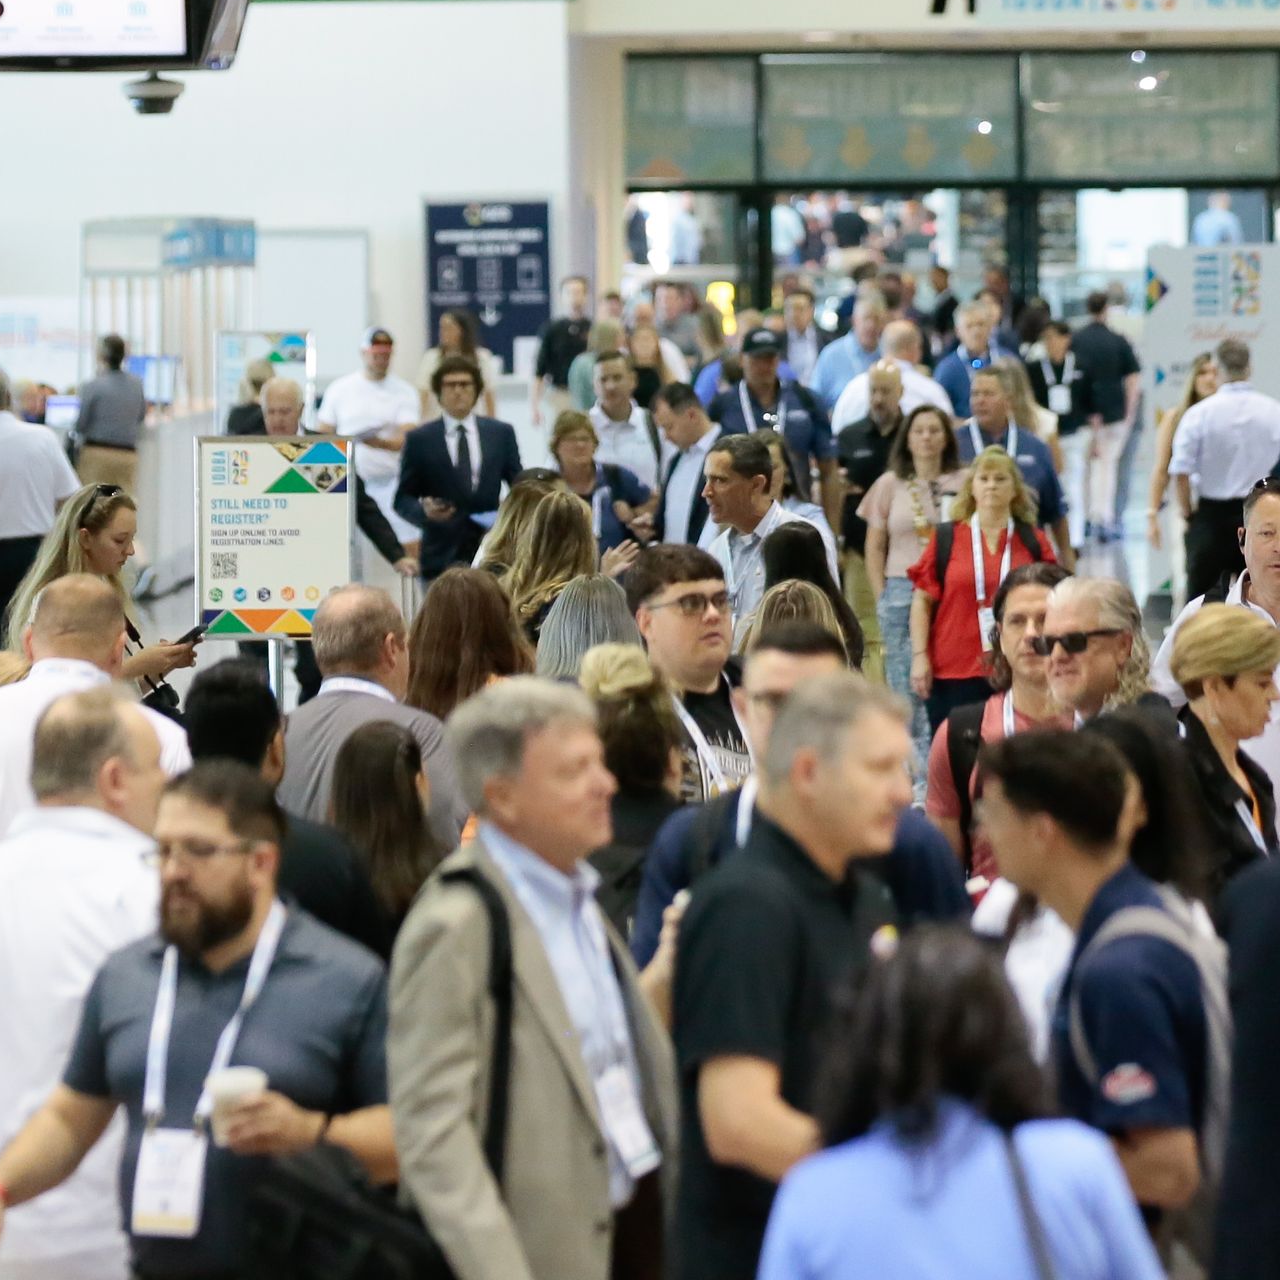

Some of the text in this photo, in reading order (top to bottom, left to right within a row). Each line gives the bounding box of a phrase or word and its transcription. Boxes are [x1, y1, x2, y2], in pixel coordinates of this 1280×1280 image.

[210, 498, 288, 509] STILL NEED TO
[210, 514, 269, 524] REGISTER?
